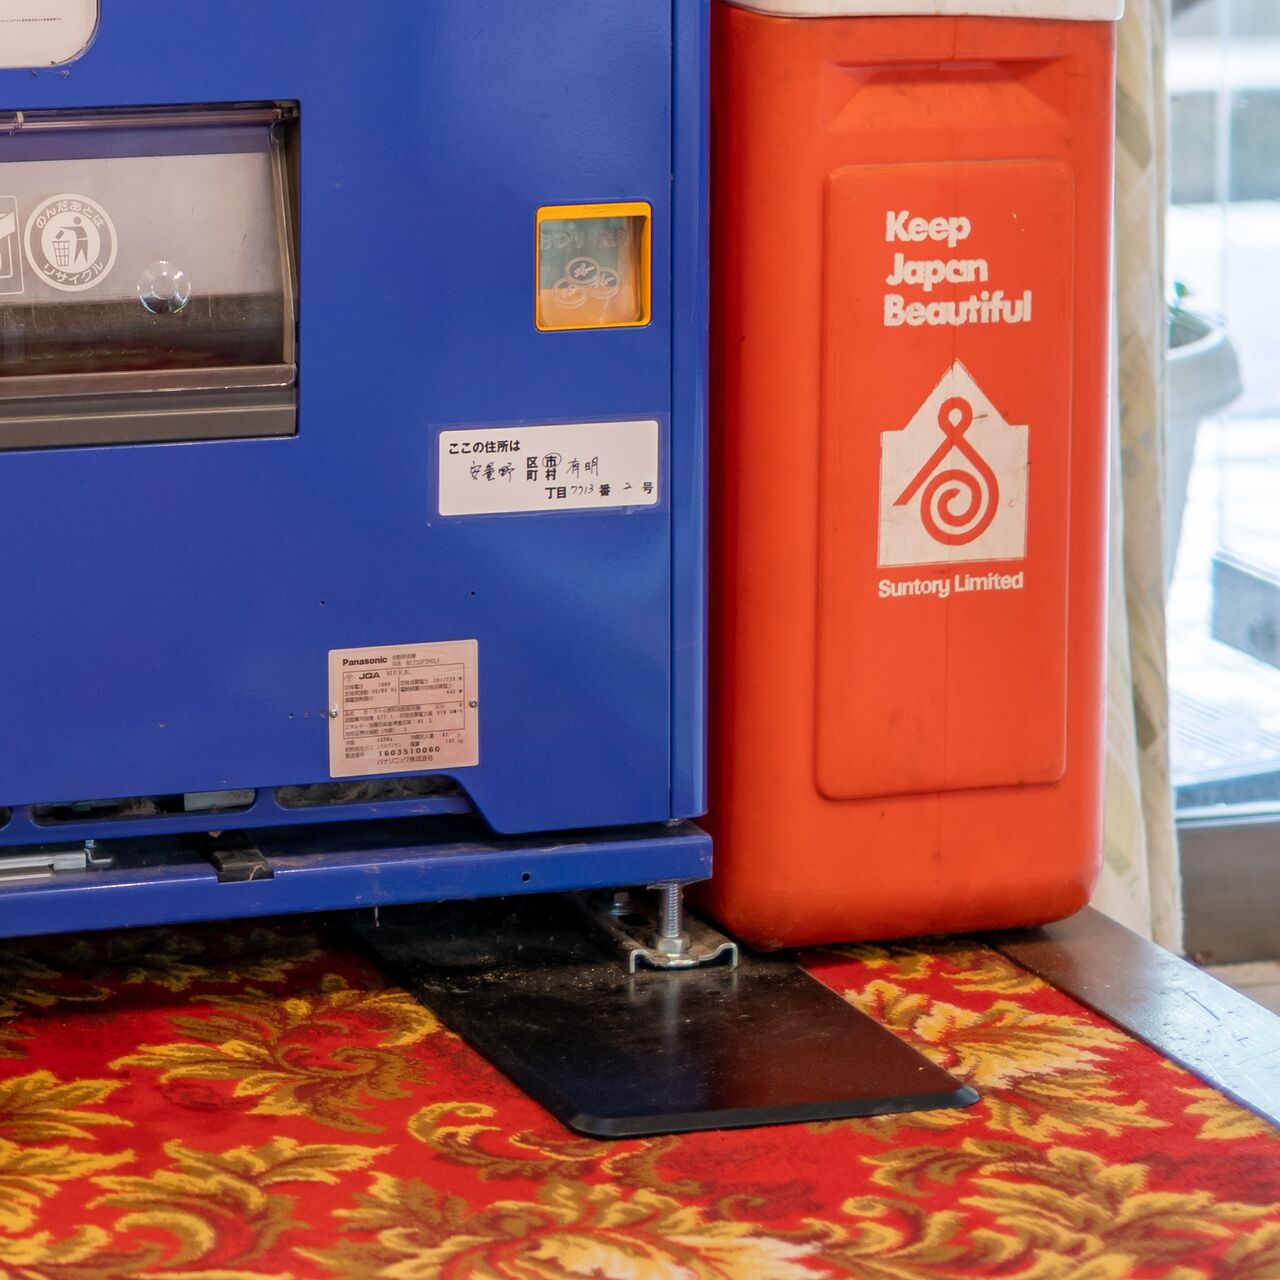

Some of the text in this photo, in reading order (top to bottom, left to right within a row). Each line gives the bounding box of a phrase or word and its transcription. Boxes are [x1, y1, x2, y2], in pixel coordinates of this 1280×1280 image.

[35, 200, 105, 230] のんだあとは
[885, 209, 972, 248] Keep
[42, 259, 104, 284] リサイクル
[885, 252, 988, 291] Japan
[883, 289, 1032, 327] Beautiful
[448, 439, 521, 455] ここの住所は
[526, 456, 538, 469] 区
[545, 455, 557, 468] 市
[526, 469, 538, 482] 町
[545, 468, 557, 481] 村
[545, 486, 567, 500] 丁目
[599, 484, 611, 497] 番
[641, 481, 654, 495] 号
[878, 571, 1024, 599] Suntory Limited
[342, 655, 388, 667] Panasonic
[358, 672, 381, 680] JQA
